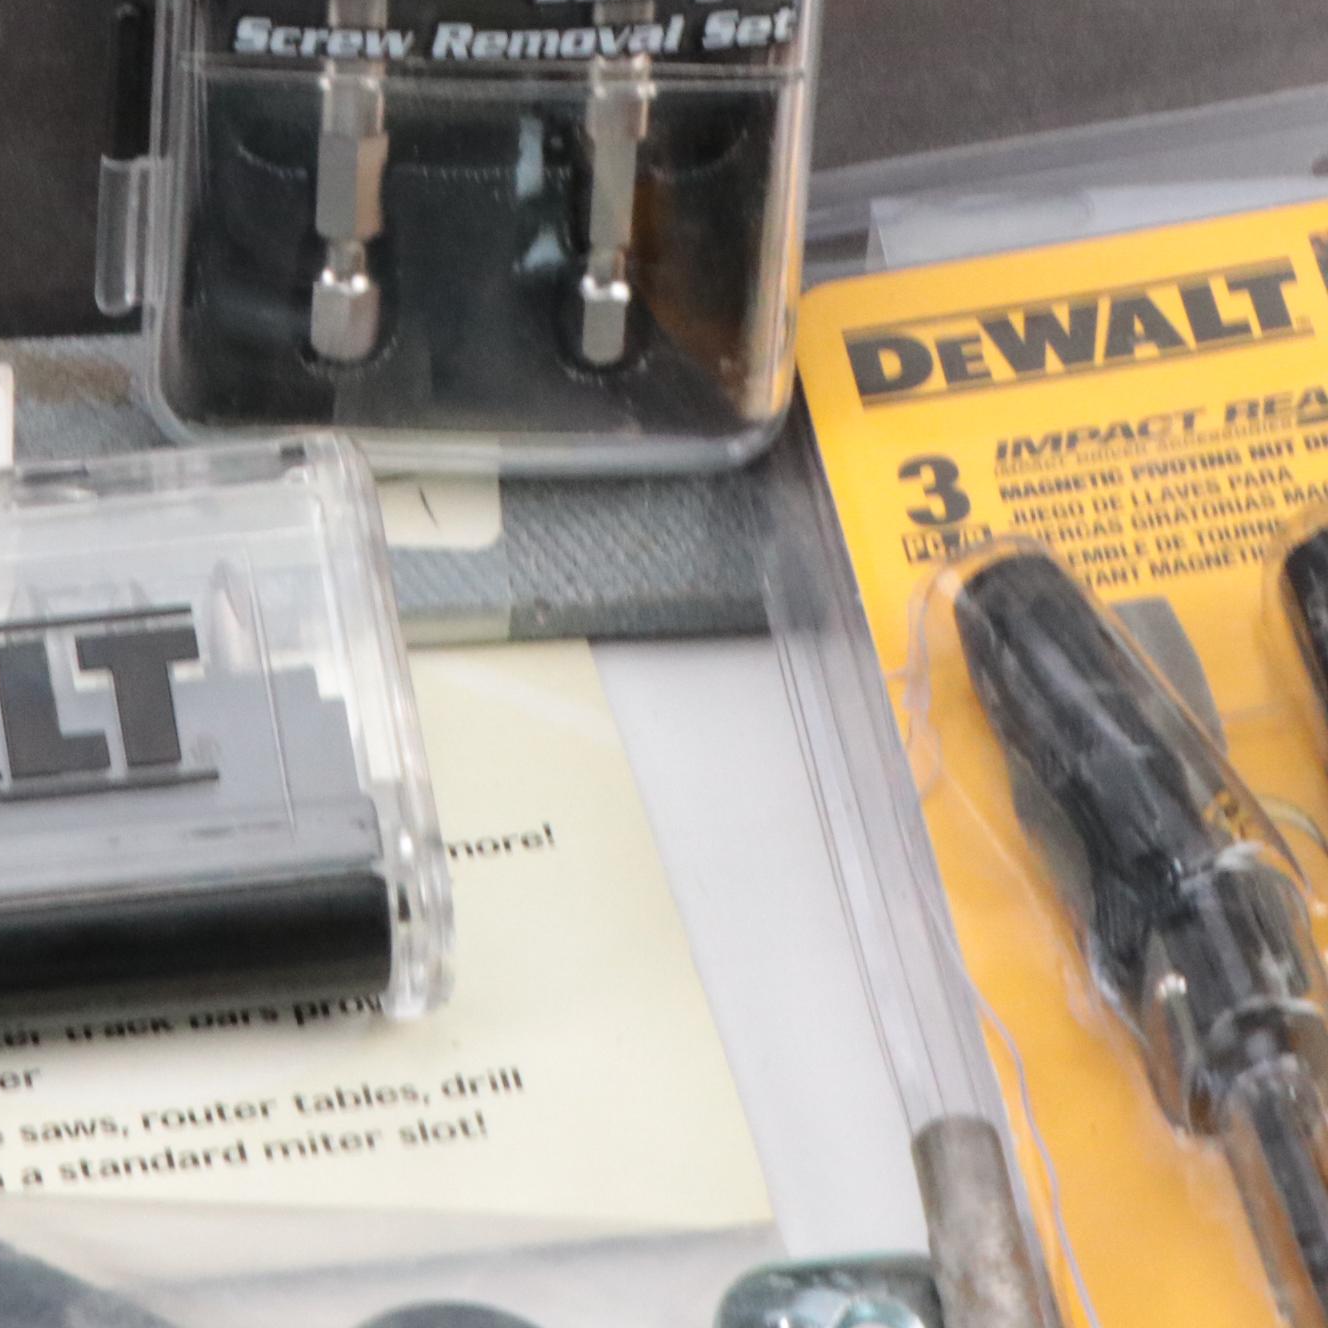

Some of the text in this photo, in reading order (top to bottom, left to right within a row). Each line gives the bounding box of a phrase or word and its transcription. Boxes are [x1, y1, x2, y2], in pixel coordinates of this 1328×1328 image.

[234, 5, 798, 60] Screw Removal Set
[843, 260, 1299, 402] DEWALT
[995, 406, 1208, 460] IMPACT
[897, 453, 971, 526] 3
[999, 468, 1123, 503] MAGNETIC
[1130, 448, 1243, 482] PIVOTING
[1248, 439, 1295, 462] NUT
[1012, 465, 1293, 526] JUEGO DE LLAVES PARA
[1131, 491, 1276, 530] GIRATORIAS
[1155, 534, 1186, 553] DE
[19, 1117, 128, 1145] saws,
[141, 1096, 277, 1132] router
[293, 1082, 430, 1116] tables,
[441, 1065, 524, 1100] drill
[21, 1168, 43, 1186] a
[60, 1140, 249, 1182] standard
[263, 1130, 383, 1161] miter
[399, 1109, 489, 1145] slot!
